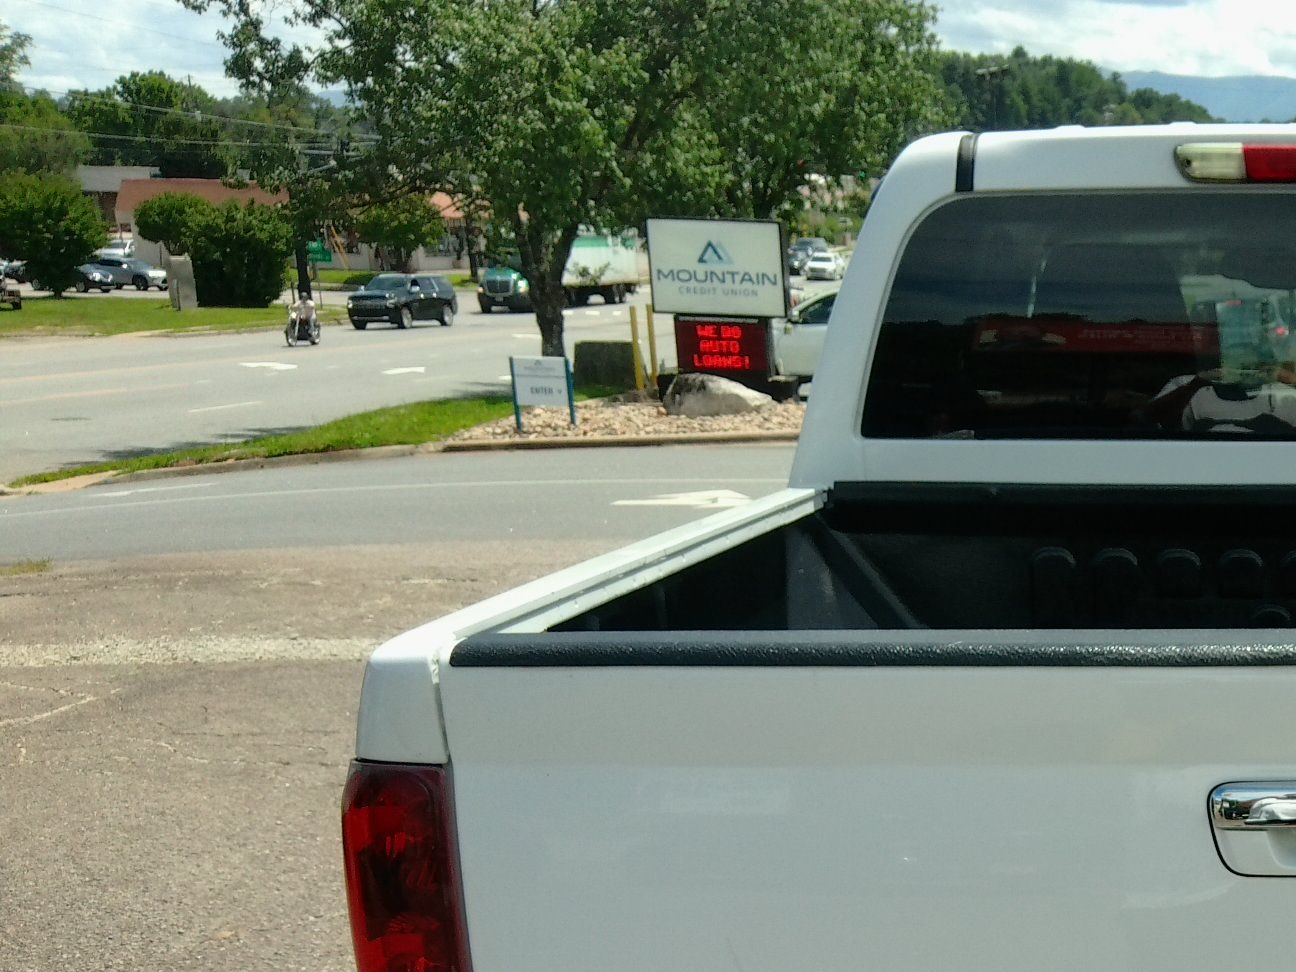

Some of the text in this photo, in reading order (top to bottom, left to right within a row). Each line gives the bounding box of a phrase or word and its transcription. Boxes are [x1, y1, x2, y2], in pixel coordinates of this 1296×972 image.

[656, 268, 778, 286] MOUNTAIN
[678, 286, 758, 297] CREDIT UNION
[696, 325, 742, 339] WE DO
[700, 340, 740, 353] AUTO
[693, 354, 750, 370] LOANS!
